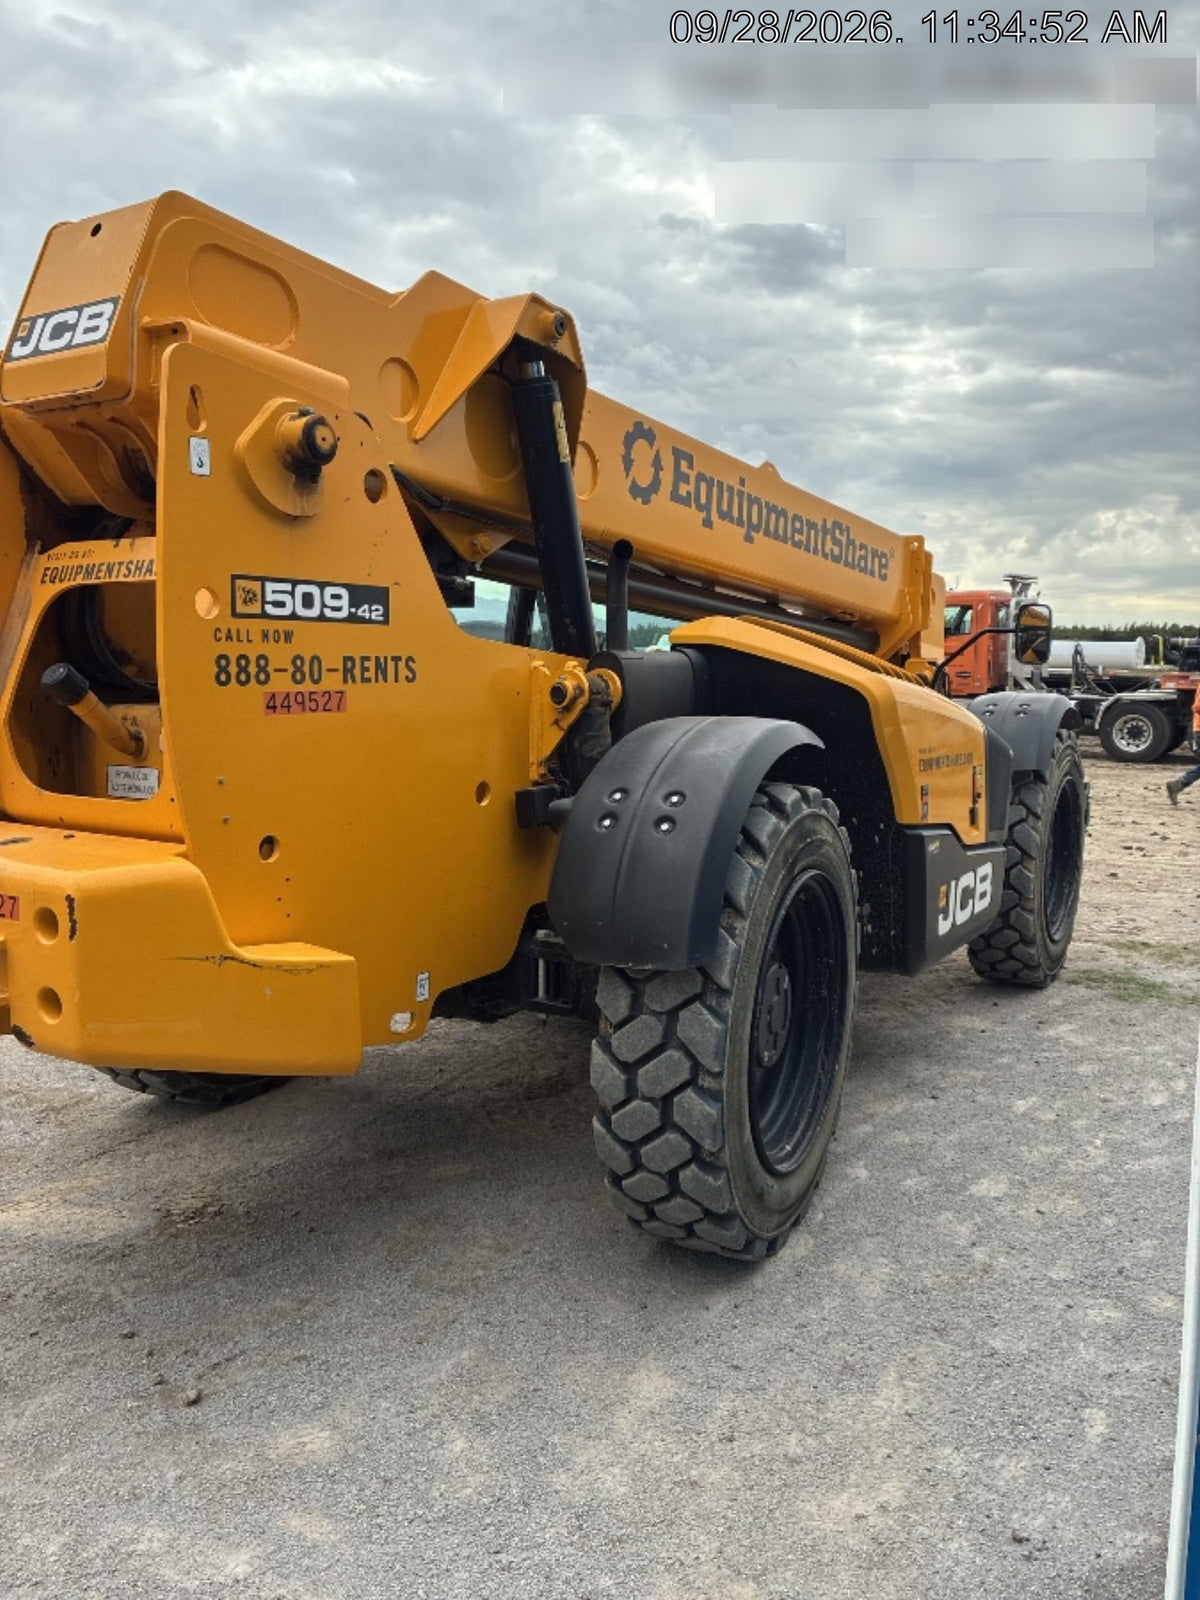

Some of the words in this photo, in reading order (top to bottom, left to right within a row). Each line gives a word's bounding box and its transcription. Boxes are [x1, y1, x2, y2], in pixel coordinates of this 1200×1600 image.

[11, 302, 114, 358] JCB
[40, 558, 157, 584] EQUIPMENTSHA
[264, 581, 385, 621] 509-42
[214, 628, 253, 643] CALL
[261, 629, 294, 644] NOW
[214, 654, 417, 686] 888-80-RENTS
[265, 691, 345, 713] 449527
[938, 861, 993, 936] JCB
